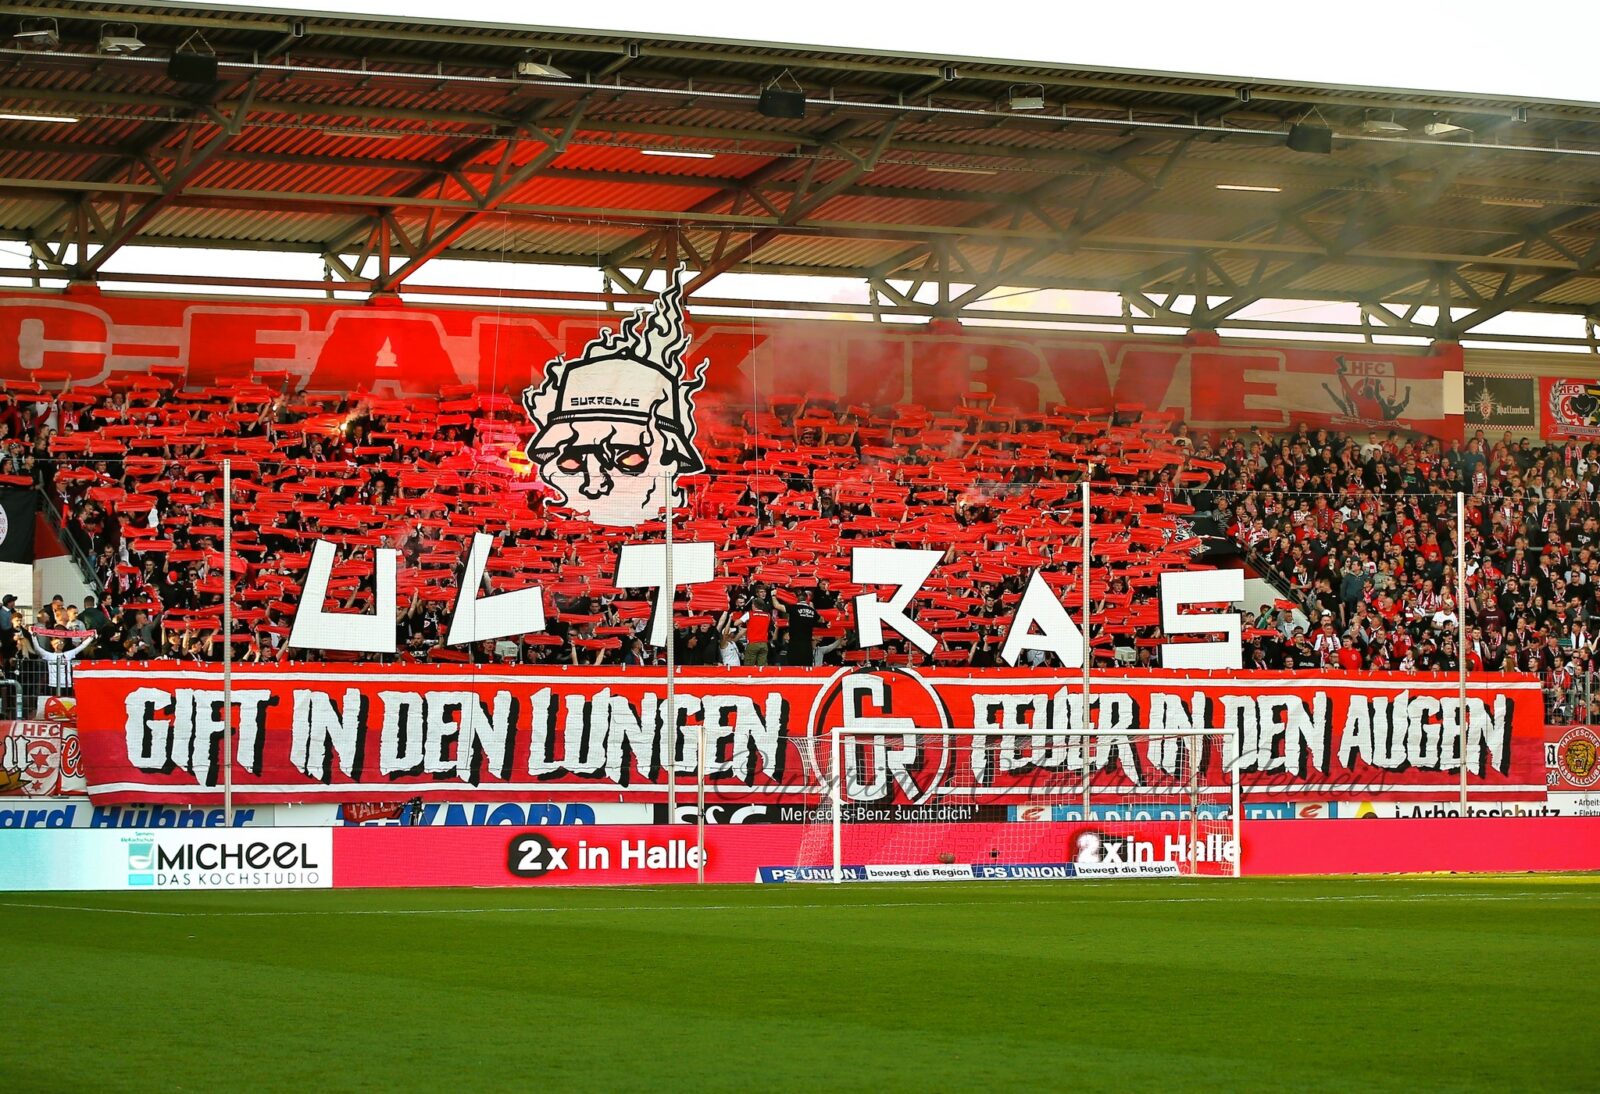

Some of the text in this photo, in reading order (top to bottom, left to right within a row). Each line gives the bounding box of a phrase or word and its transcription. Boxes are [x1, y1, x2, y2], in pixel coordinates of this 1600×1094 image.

[1351, 361, 1386, 376] HFC
[1560, 385, 1580, 394] HFC
[571, 396, 640, 408] SURREALE
[288, 532, 1245, 670] ULTRAS
[23, 724, 60, 737] HFC
[124, 687, 279, 788] GIFT
[289, 688, 369, 785] IN
[377, 689, 519, 787] DEN
[529, 687, 790, 787] LUNGEN
[971, 686, 1514, 786] FEUER IN DEN AUGEN
[1560, 729, 1600, 748] HALLESCHER
[89, 803, 255, 828] Hübner
[780, 806, 972, 822] Merceds-Benz sucht dich!
[1160, 809, 1282, 821] BROCEN
[1395, 805, 1561, 818] i-Arbetsschutz
[517, 839, 708, 871] 2x in Halle
[1076, 832, 1242, 865] 2x in Halle
[771, 869, 797, 881] PS
[870, 868, 970, 878] bewegt die Region
[983, 866, 1066, 878] PS UNION
[1078, 864, 1177, 875] bewegt die Region
[157, 872, 319, 886] DAS KOCHSTUDIO
